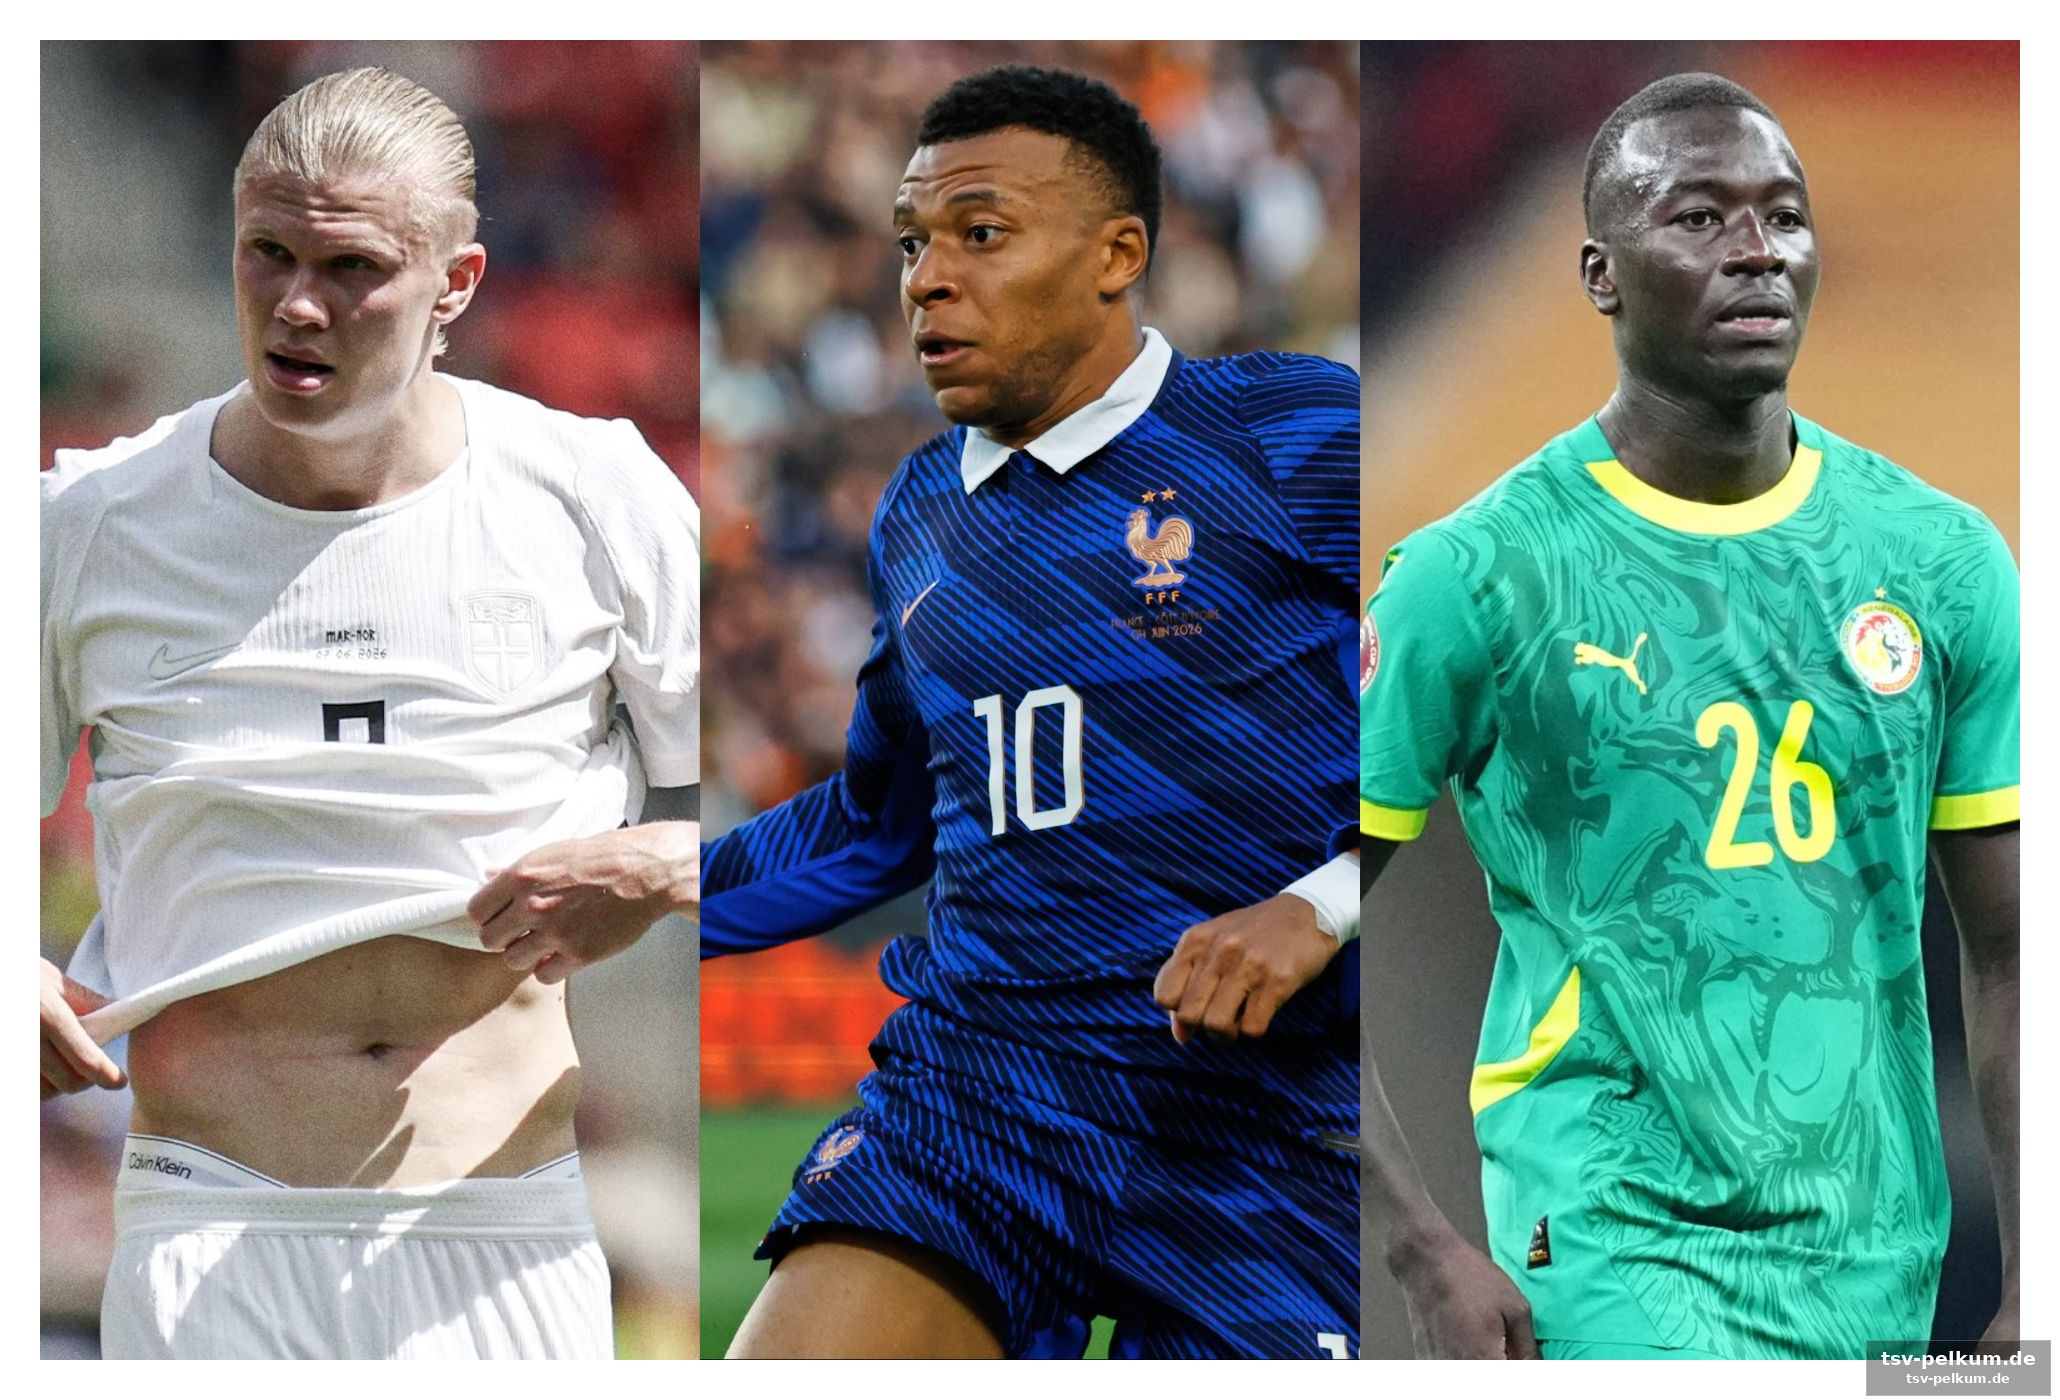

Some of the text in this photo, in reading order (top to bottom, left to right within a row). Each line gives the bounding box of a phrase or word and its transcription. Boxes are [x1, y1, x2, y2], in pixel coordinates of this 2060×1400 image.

[1145, 590, 1180, 605] FFF
[325, 629, 376, 643] MAR-NOR
[1173, 622, 1203, 637] 2026
[973, 684, 1085, 836] 10
[1695, 699, 1836, 870] 26
[154, 1156, 192, 1179] Klein
